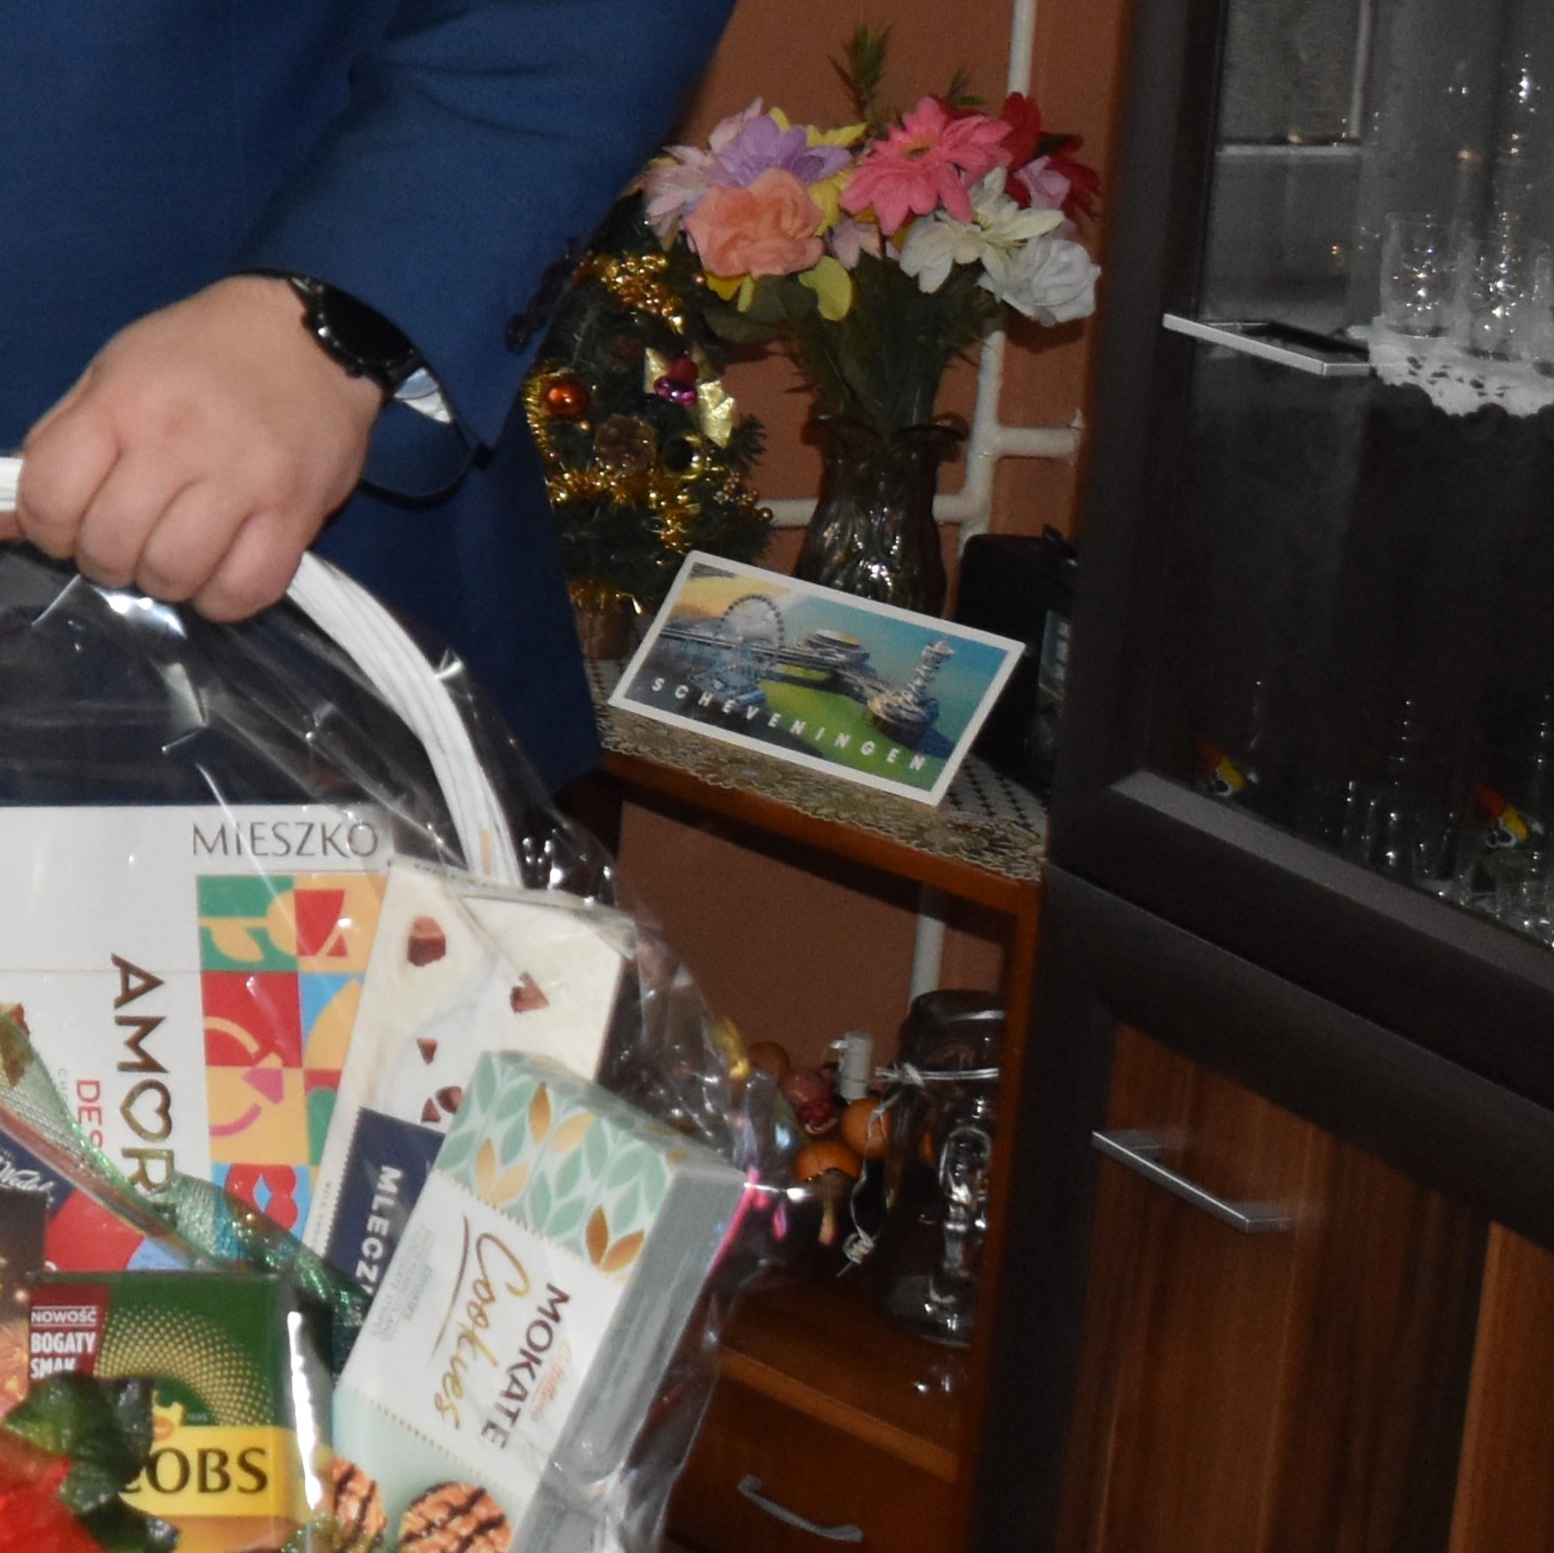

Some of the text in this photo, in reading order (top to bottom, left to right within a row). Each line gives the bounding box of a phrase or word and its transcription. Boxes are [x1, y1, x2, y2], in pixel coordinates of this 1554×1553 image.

[652, 676, 927, 771] SCHEVENINGEN
[193, 821, 379, 857] MIESZKO
[110, 952, 177, 1226] AMOR
[355, 1165, 403, 1295] MLECZ
[30, 1332, 97, 1354] BOGATY
[434, 1232, 531, 1429] Cookies
[481, 1282, 571, 1449] MOKATE
[123, 1447, 269, 1494] OBS
